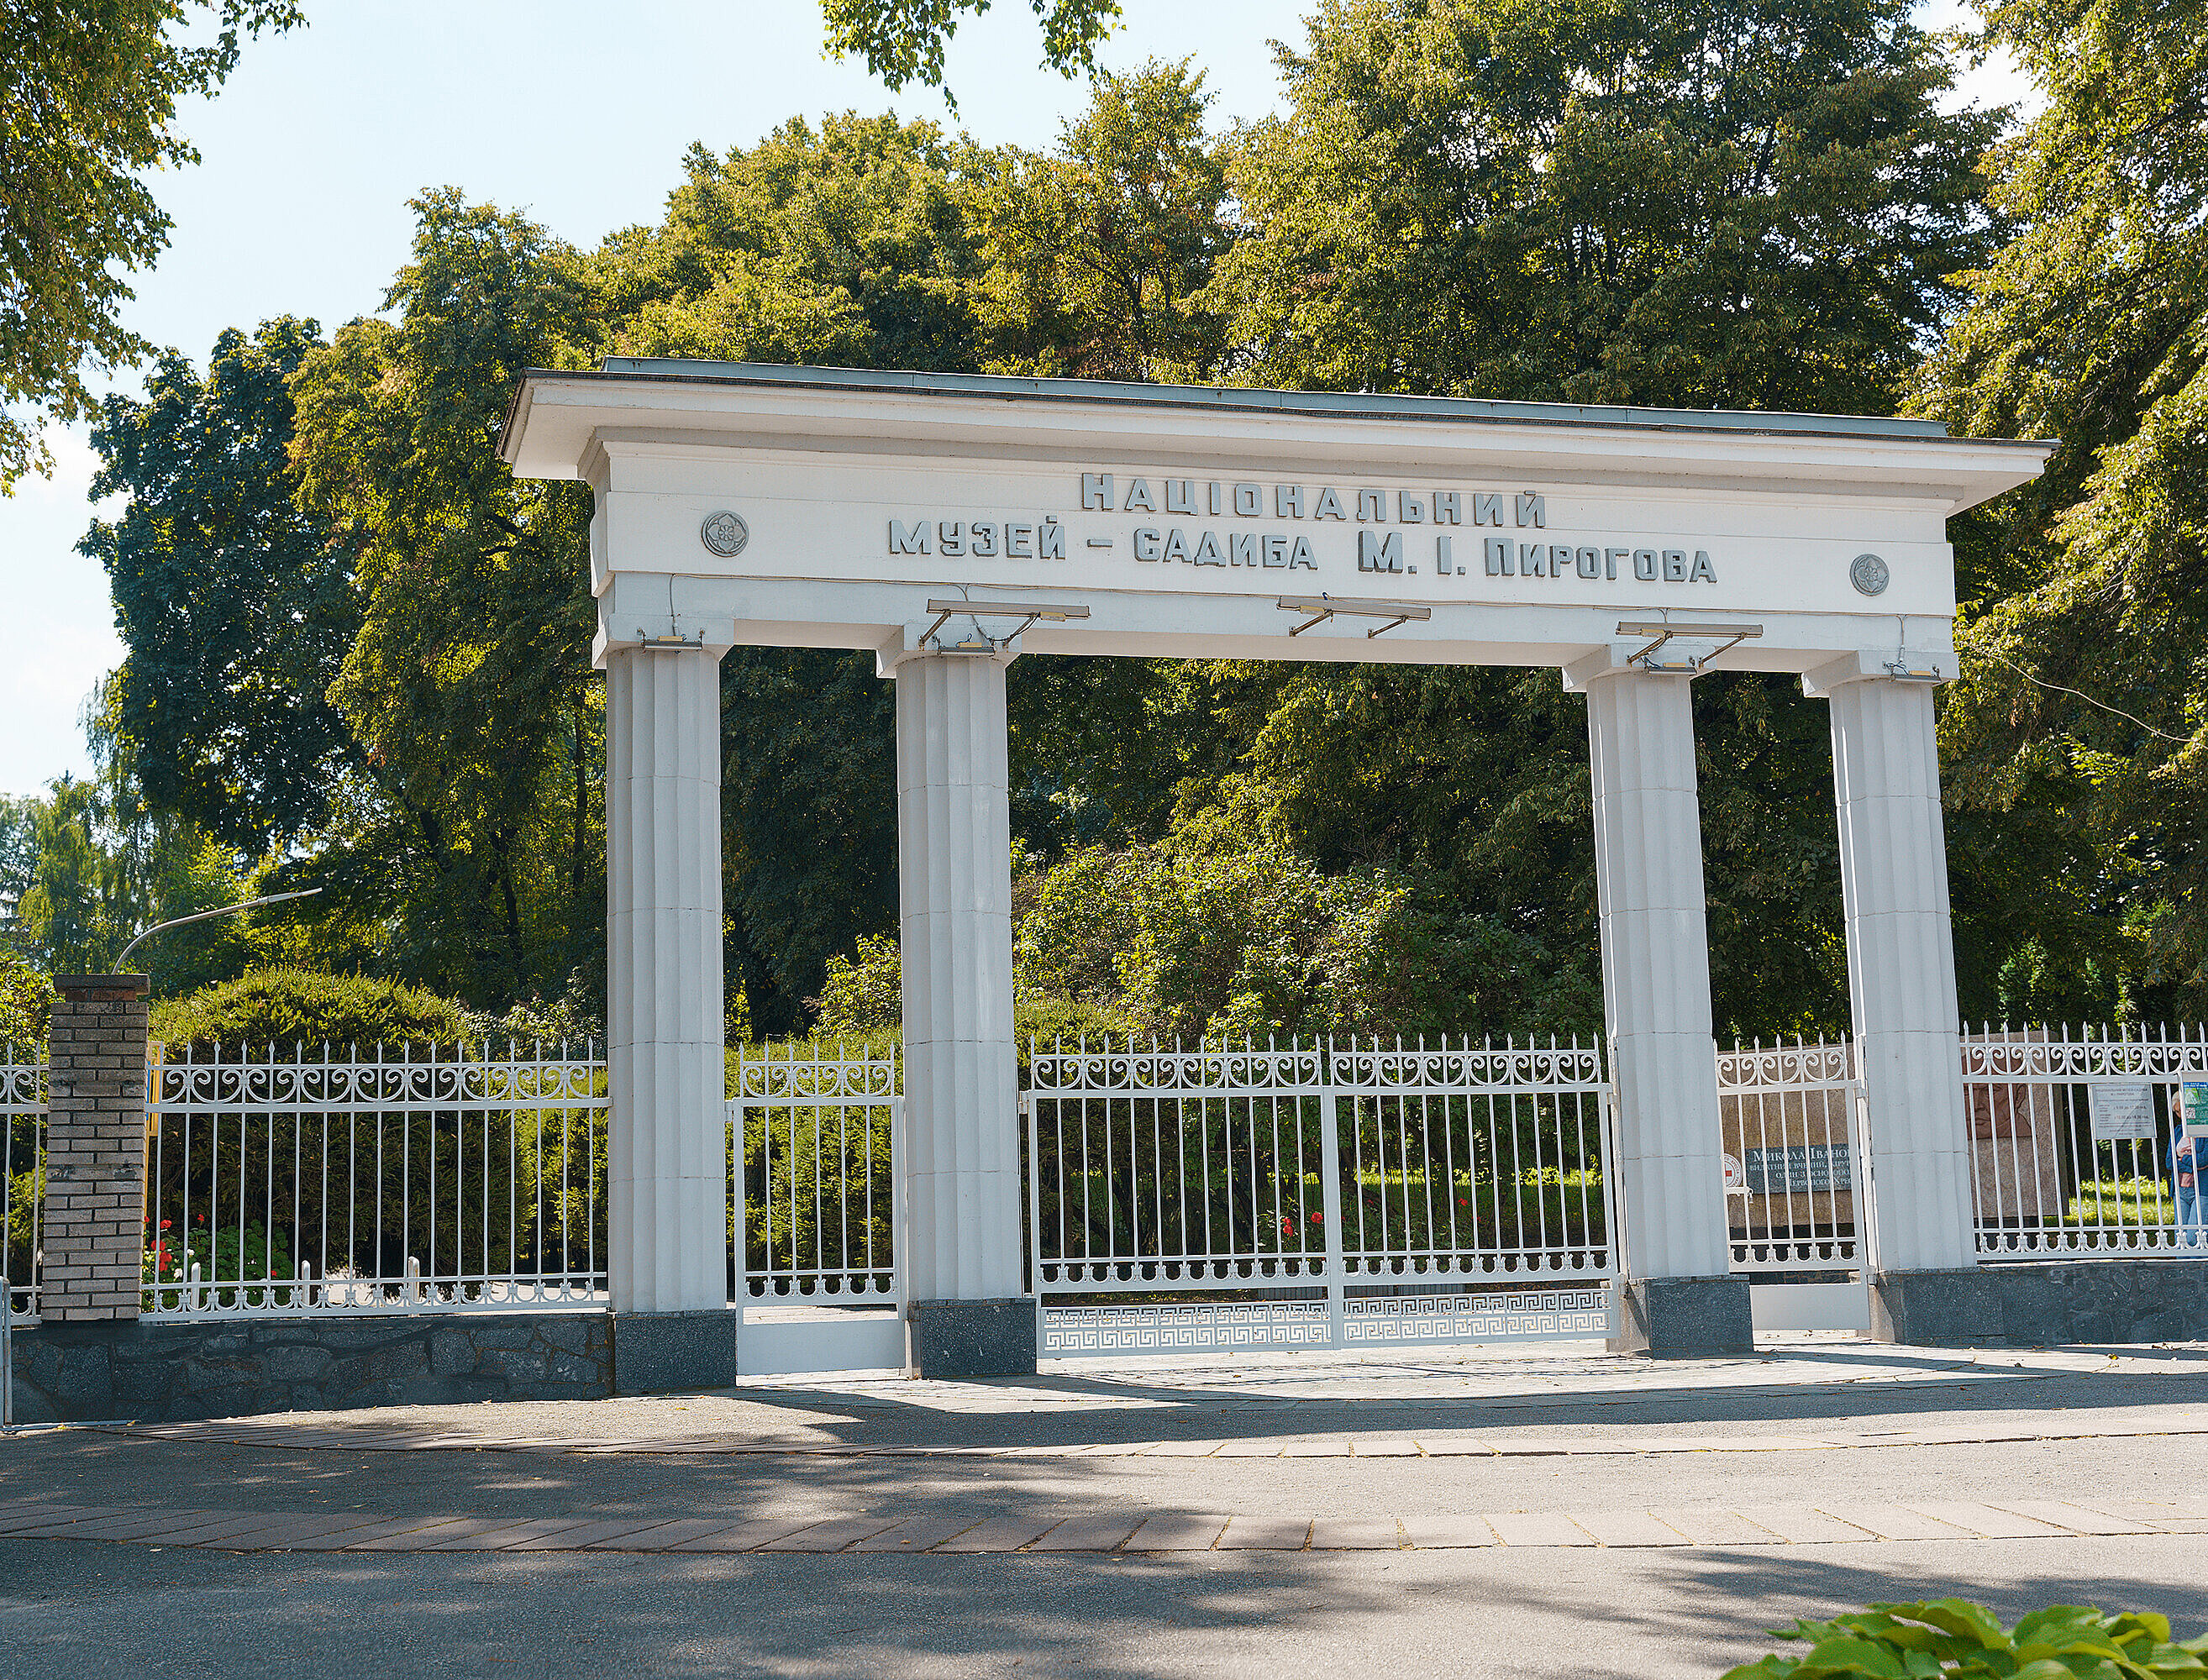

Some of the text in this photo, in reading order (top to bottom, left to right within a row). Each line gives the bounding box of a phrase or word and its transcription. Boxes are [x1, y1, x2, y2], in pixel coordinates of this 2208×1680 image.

[1081, 473, 1546, 528] НАЦІОНАЛЬНИЙ
[888, 515, 1065, 559] МУЗЕЙ
[1133, 528, 1317, 570] САДИБА
[1358, 530, 1417, 574] М.
[1484, 538, 1717, 584] ПИРОГОВА
[1810, 1147, 1849, 1159] ІВАНО
